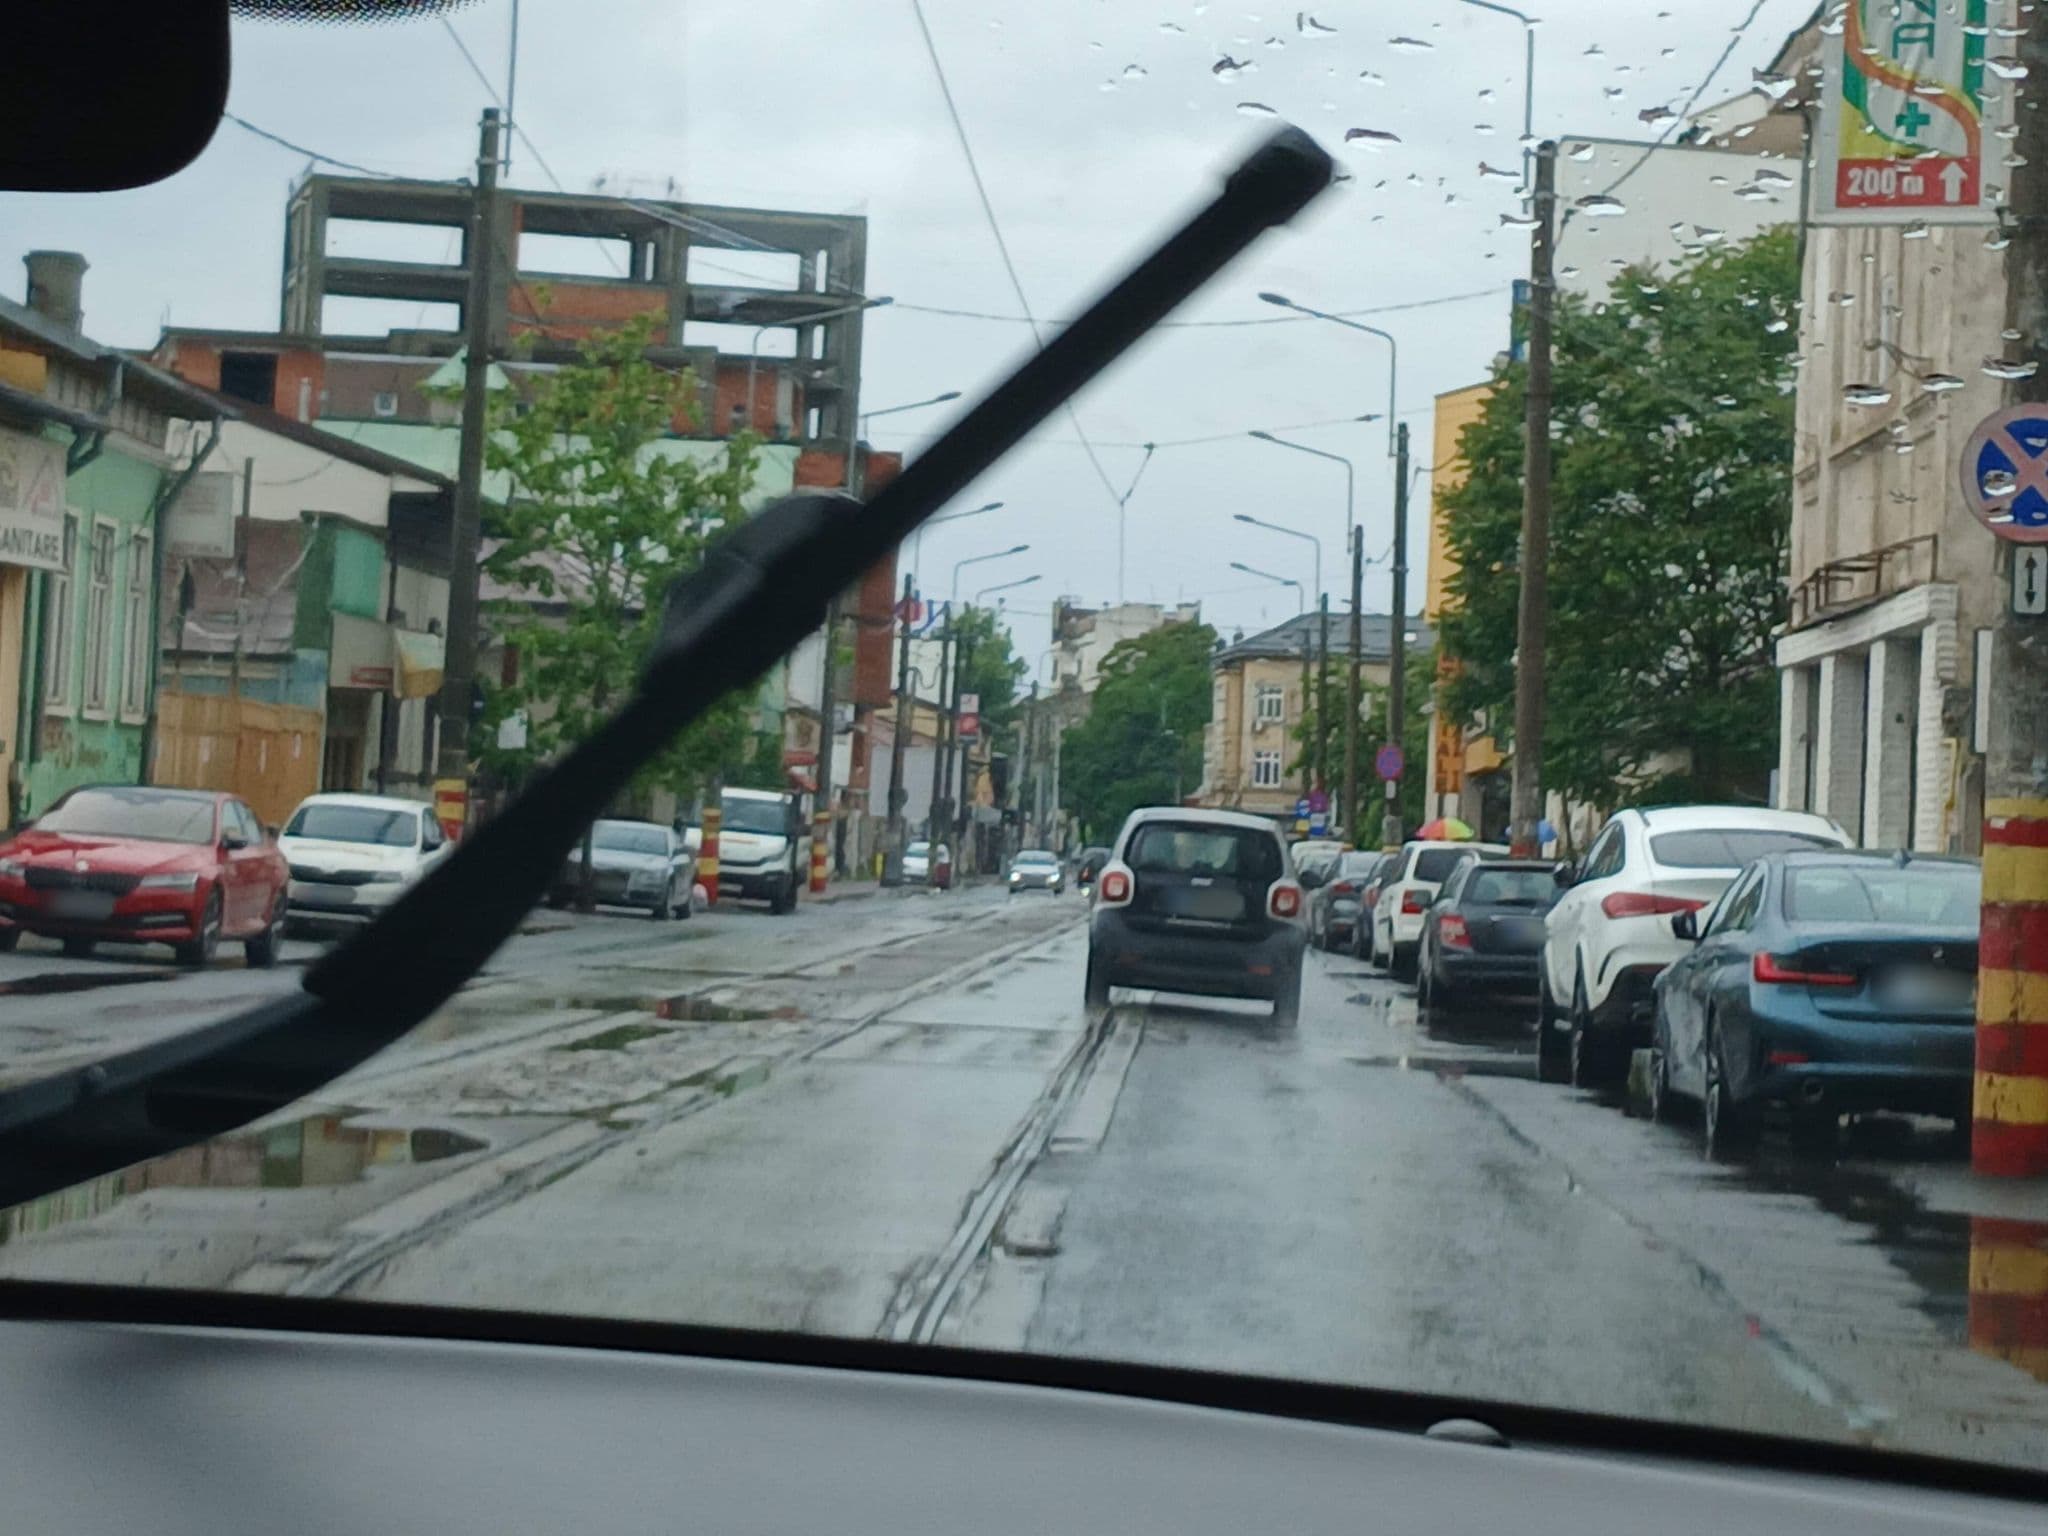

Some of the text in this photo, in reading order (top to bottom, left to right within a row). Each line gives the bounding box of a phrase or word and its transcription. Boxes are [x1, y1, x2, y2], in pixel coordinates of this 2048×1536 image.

[1846, 167, 1925, 197] 200 m
[0, 526, 59, 561] ANITARE
